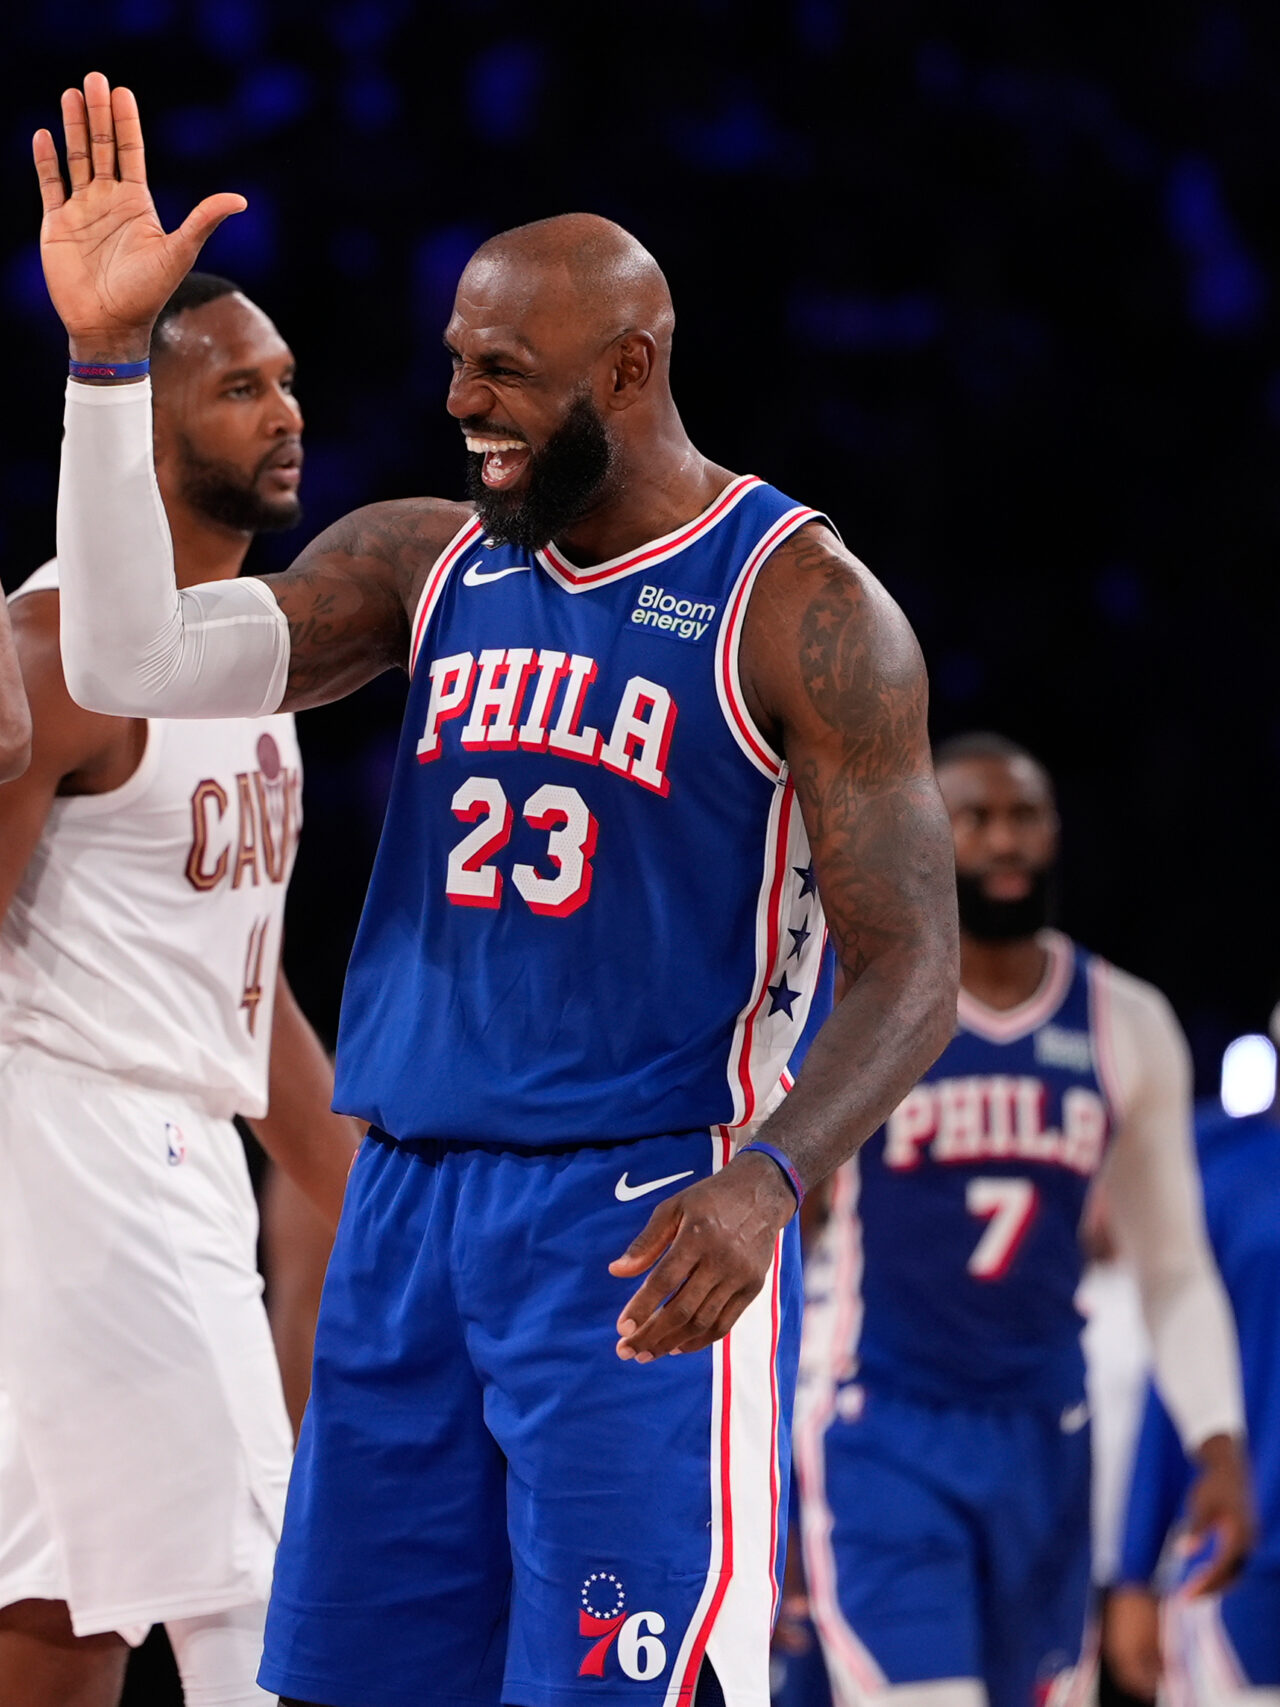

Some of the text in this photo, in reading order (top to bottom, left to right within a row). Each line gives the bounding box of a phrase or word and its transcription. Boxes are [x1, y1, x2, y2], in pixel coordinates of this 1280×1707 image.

[631, 608, 710, 641] energy
[638, 585, 716, 621] Bloom
[416, 648, 678, 798] PHILA
[184, 766, 302, 892] CAV
[446, 776, 599, 918] 23
[240, 914, 270, 1039] 4
[883, 1074, 1108, 1177] PHILA
[965, 1175, 1039, 1281] 7
[578, 1610, 667, 1681] 76
